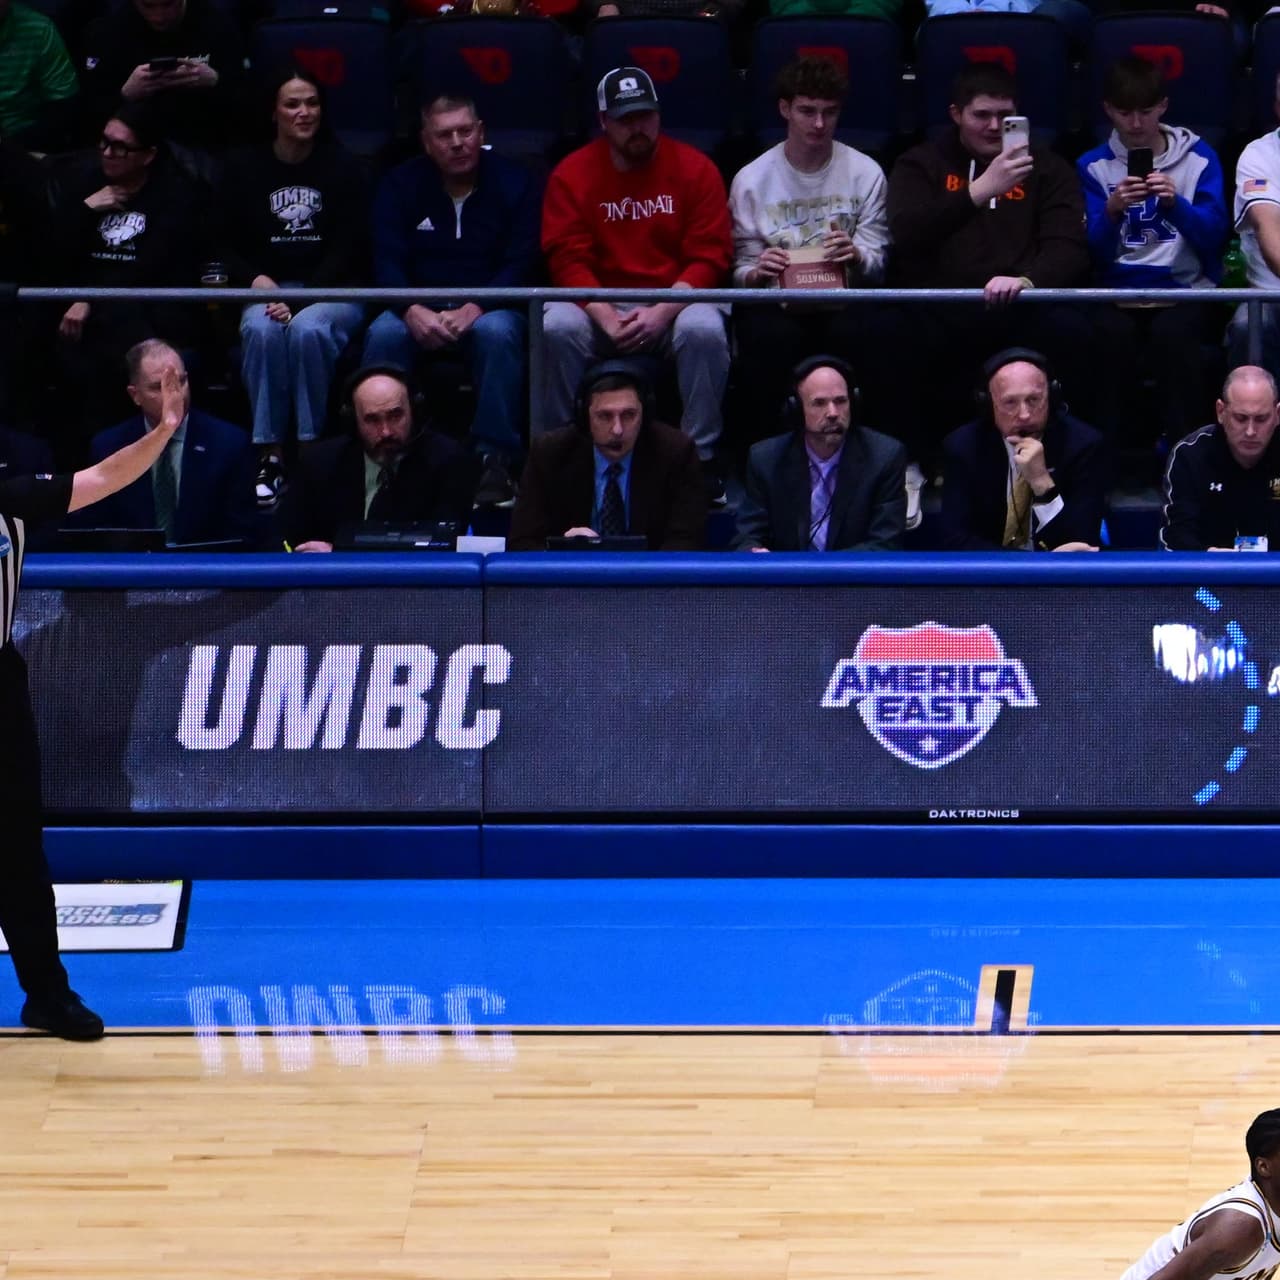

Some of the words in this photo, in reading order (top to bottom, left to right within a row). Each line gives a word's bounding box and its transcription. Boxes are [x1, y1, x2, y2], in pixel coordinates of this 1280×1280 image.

[270, 185, 323, 213] UMBC
[796, 271, 837, 284] DONATOS
[831, 663, 1024, 700] AMERICA
[177, 645, 511, 750] UMBC
[876, 694, 982, 723] EAST
[929, 808, 1019, 818] DAKTRONICS
